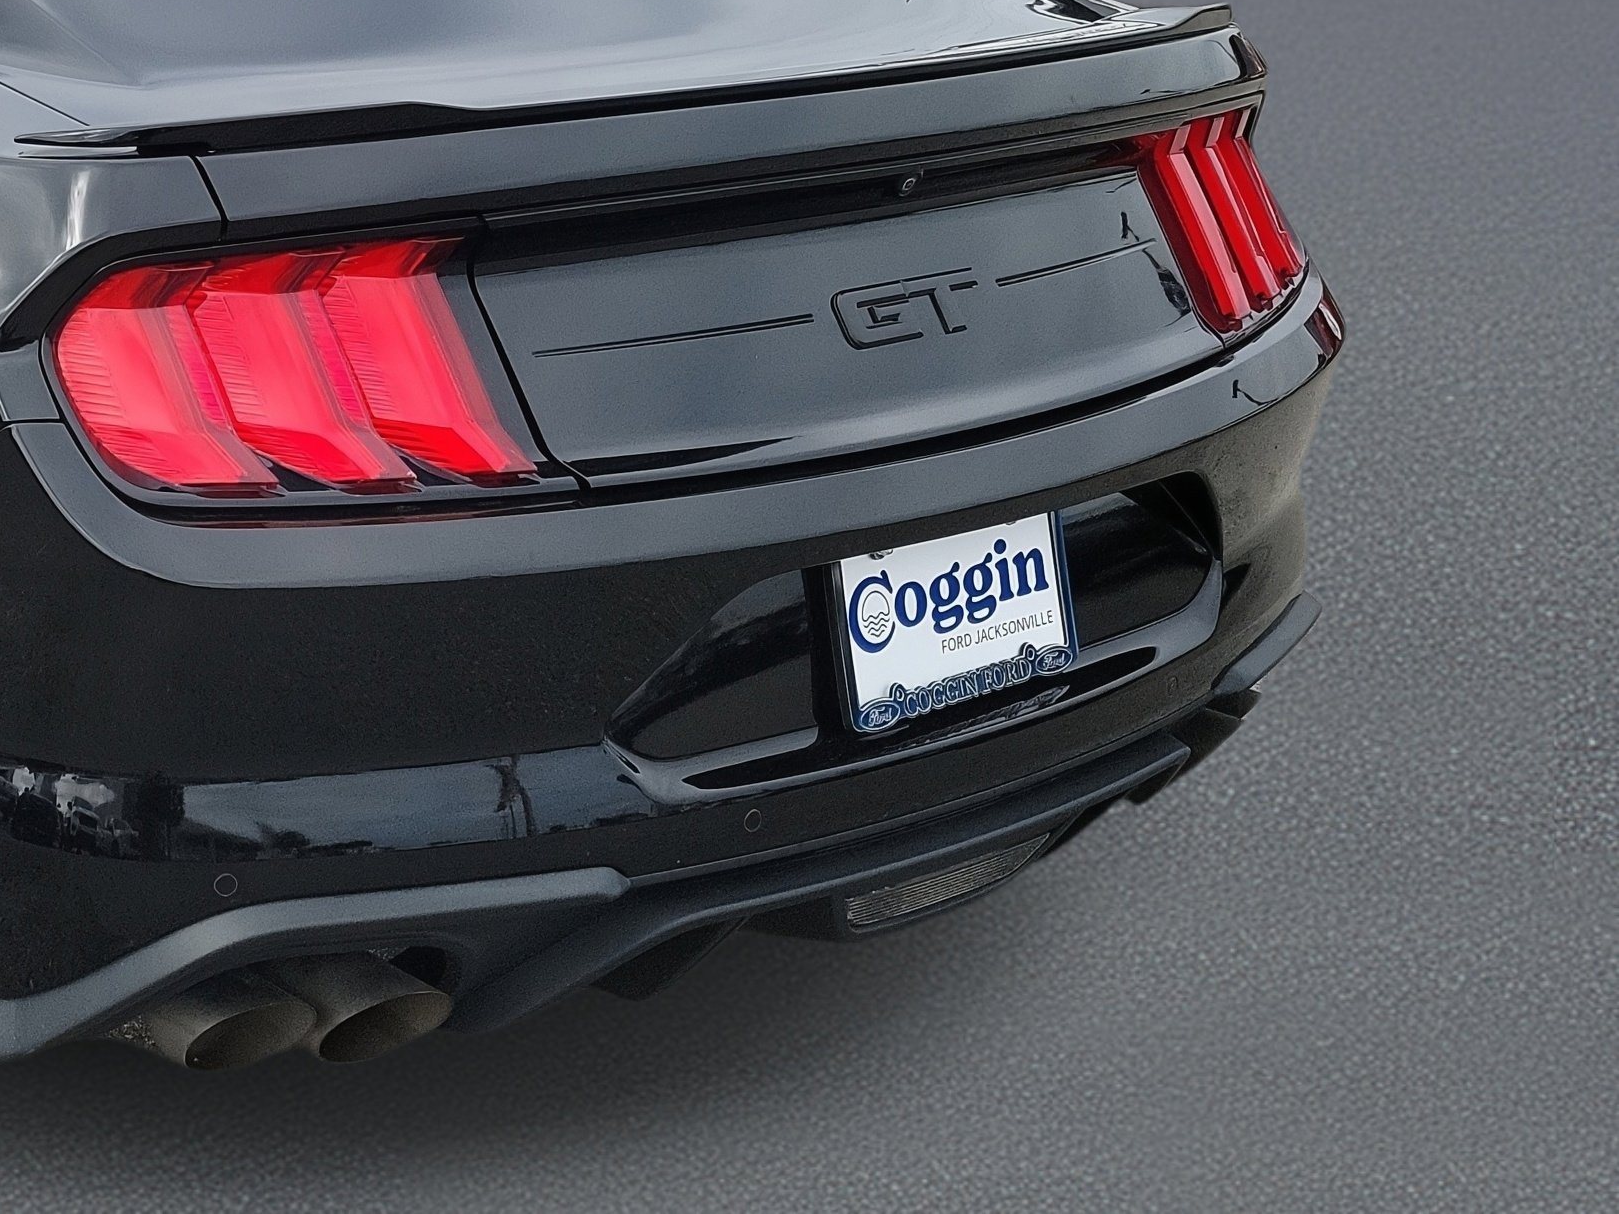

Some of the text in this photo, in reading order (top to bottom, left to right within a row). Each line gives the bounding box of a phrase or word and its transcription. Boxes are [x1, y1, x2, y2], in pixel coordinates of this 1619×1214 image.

[830, 267, 979, 351] GT
[848, 538, 1050, 654] Coggin
[941, 609, 1054, 655] FORD JACKSONVILLE
[904, 671, 979, 717] COGGIN
[982, 657, 1032, 695] FORD
